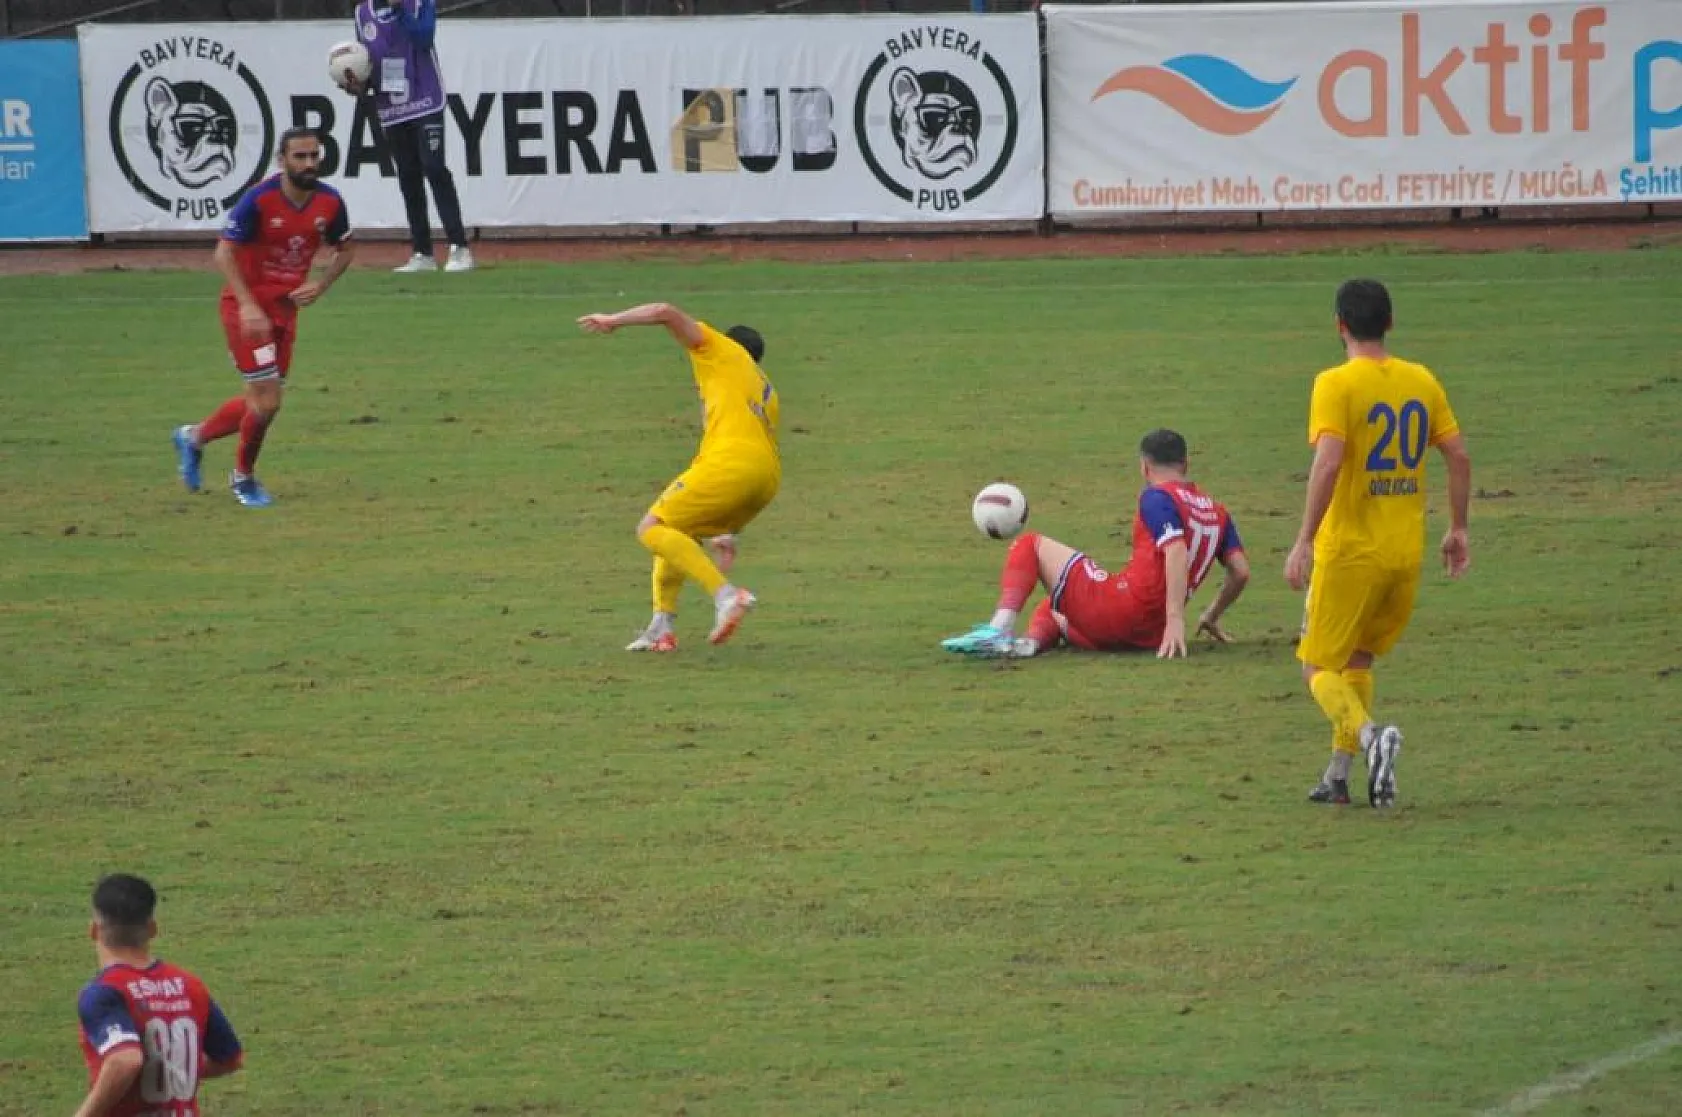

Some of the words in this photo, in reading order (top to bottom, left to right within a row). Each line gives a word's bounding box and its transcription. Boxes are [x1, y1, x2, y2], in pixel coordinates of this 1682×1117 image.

[140, 36, 236, 69] BAVYERA
[886, 26, 981, 60] BAVYERA
[1317, 7, 1607, 137] aktif
[290, 90, 657, 178] BAYERA
[683, 87, 838, 173] PUB
[176, 197, 219, 220] PUB
[918, 188, 961, 211] PUB
[1073, 178, 1206, 212] Cumhuriyet
[1211, 175, 1266, 206] Mah.
[1273, 175, 1331, 211] Çarşı
[1338, 173, 1391, 204] Cad.
[1397, 164, 1496, 202] FETHİYE
[1501, 169, 1514, 201] /
[1519, 162, 1608, 199] MUĞLA
[1366, 399, 1428, 471] 20
[142, 1015, 197, 1103] 80
